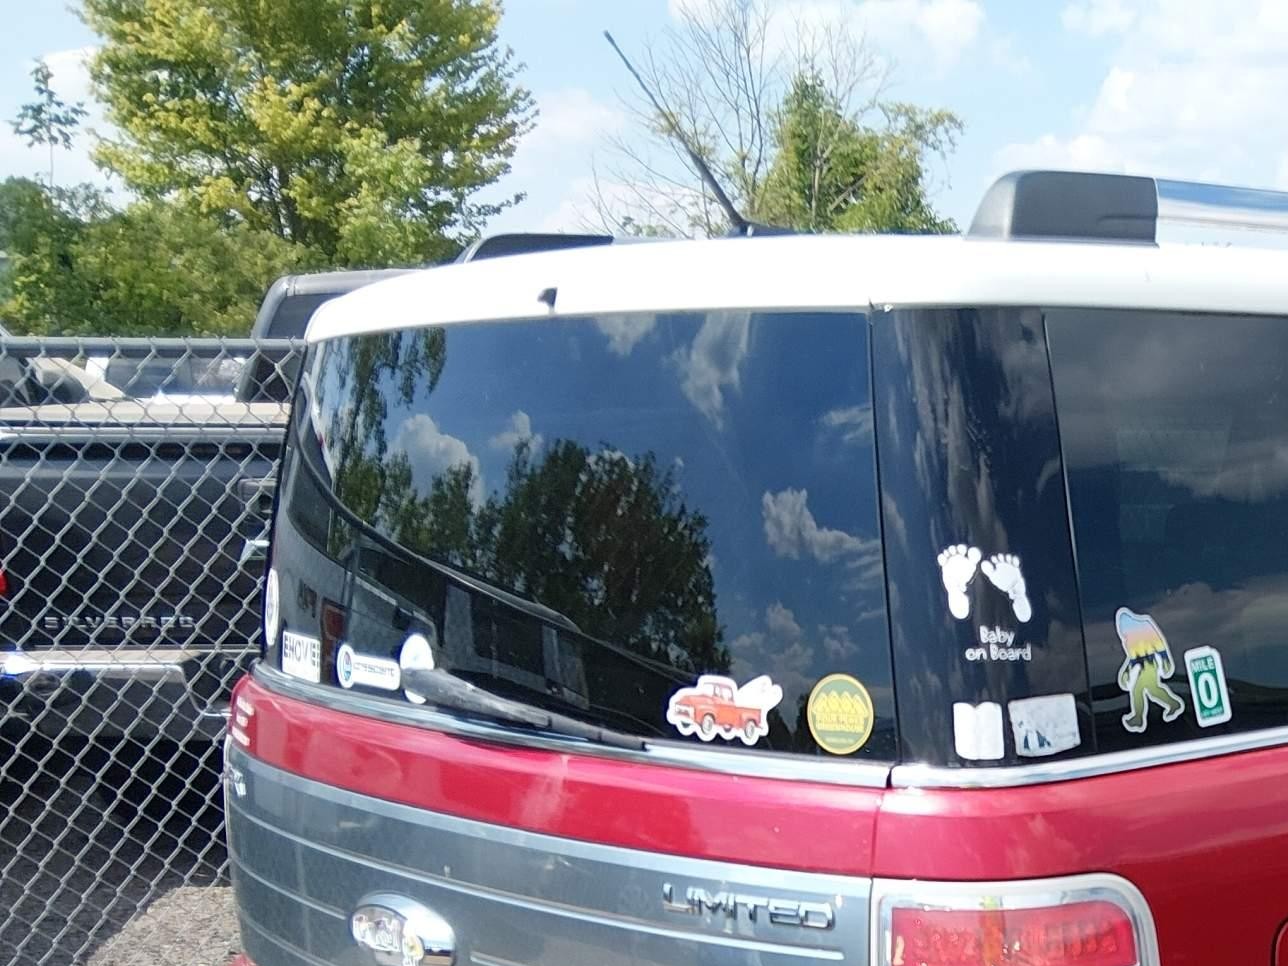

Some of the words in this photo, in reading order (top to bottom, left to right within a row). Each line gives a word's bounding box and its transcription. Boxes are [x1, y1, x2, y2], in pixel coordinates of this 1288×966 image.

[979, 625, 1015, 647] Baby
[965, 647, 987, 660] on
[989, 642, 1032, 661] Board
[1191, 655, 1216, 673] MILE
[1198, 671, 1219, 709] 0
[662, 882, 836, 931] LIMITED
